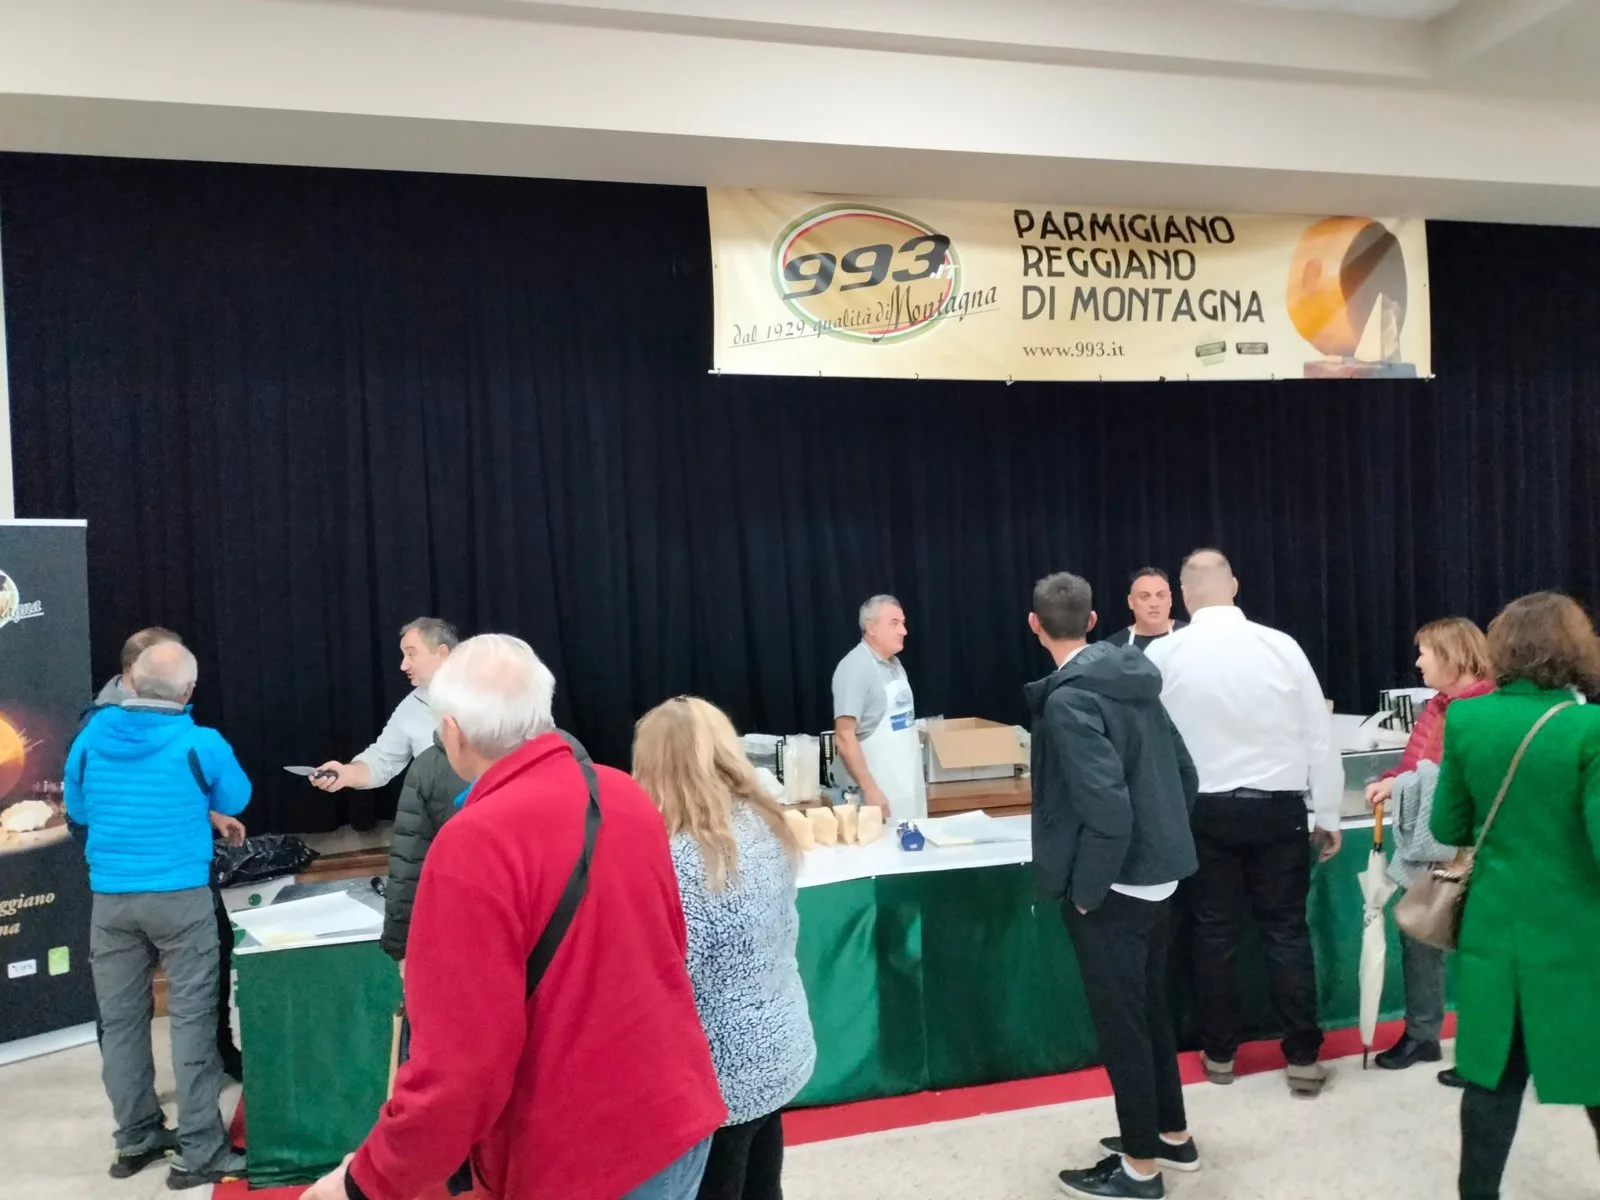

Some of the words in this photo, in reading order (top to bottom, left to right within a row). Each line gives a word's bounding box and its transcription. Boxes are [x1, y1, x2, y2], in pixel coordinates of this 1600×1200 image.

[1013, 209, 1235, 244] PARMIGIANO
[1021, 244, 1196, 281] REGGIANO
[1022, 285, 1056, 321] DI
[1070, 286, 1265, 323] MONTAGNA
[733, 324, 758, 345] dal
[766, 320, 806, 339] 1929
[813, 306, 872, 339] qualità
[1023, 340, 1126, 358] www.993.it
